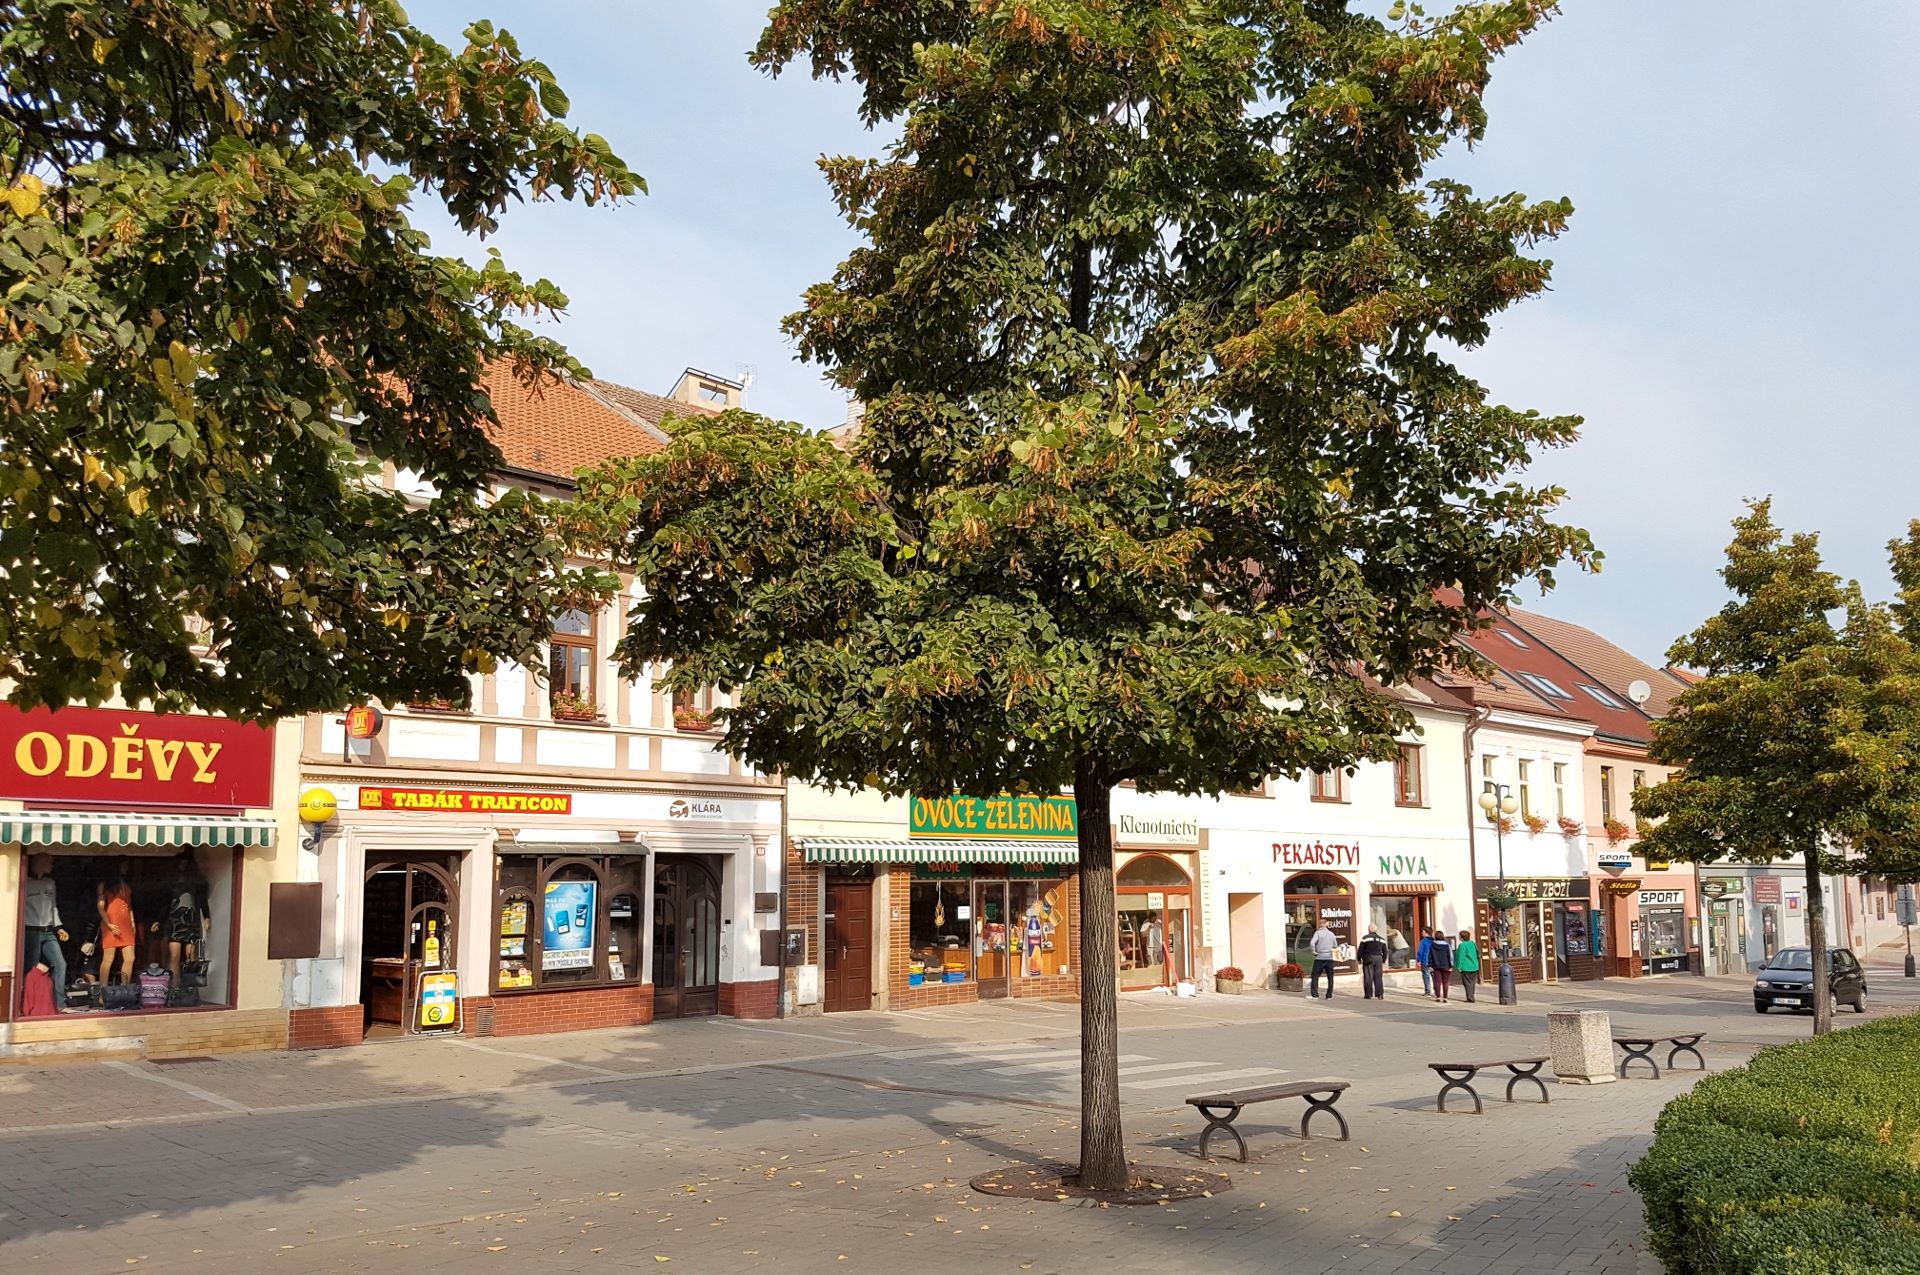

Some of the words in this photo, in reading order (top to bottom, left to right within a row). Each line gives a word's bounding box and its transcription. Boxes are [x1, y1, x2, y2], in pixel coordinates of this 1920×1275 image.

[15, 722, 222, 784] ODĚVY
[392, 791, 463, 809] TABÁK
[469, 795, 567, 811] TRAFICON
[691, 800, 722, 813] KLÁRA
[1119, 814, 1197, 836] Klenotnictví
[1271, 840, 1360, 866] PEKAŘSTVÍ
[1378, 855, 1428, 876] NOVA
[1542, 879, 1570, 897] ZBOŽÍ
[1640, 892, 1680, 903] SPORT
[1327, 919, 1349, 929] EKAŘSTVÍ
